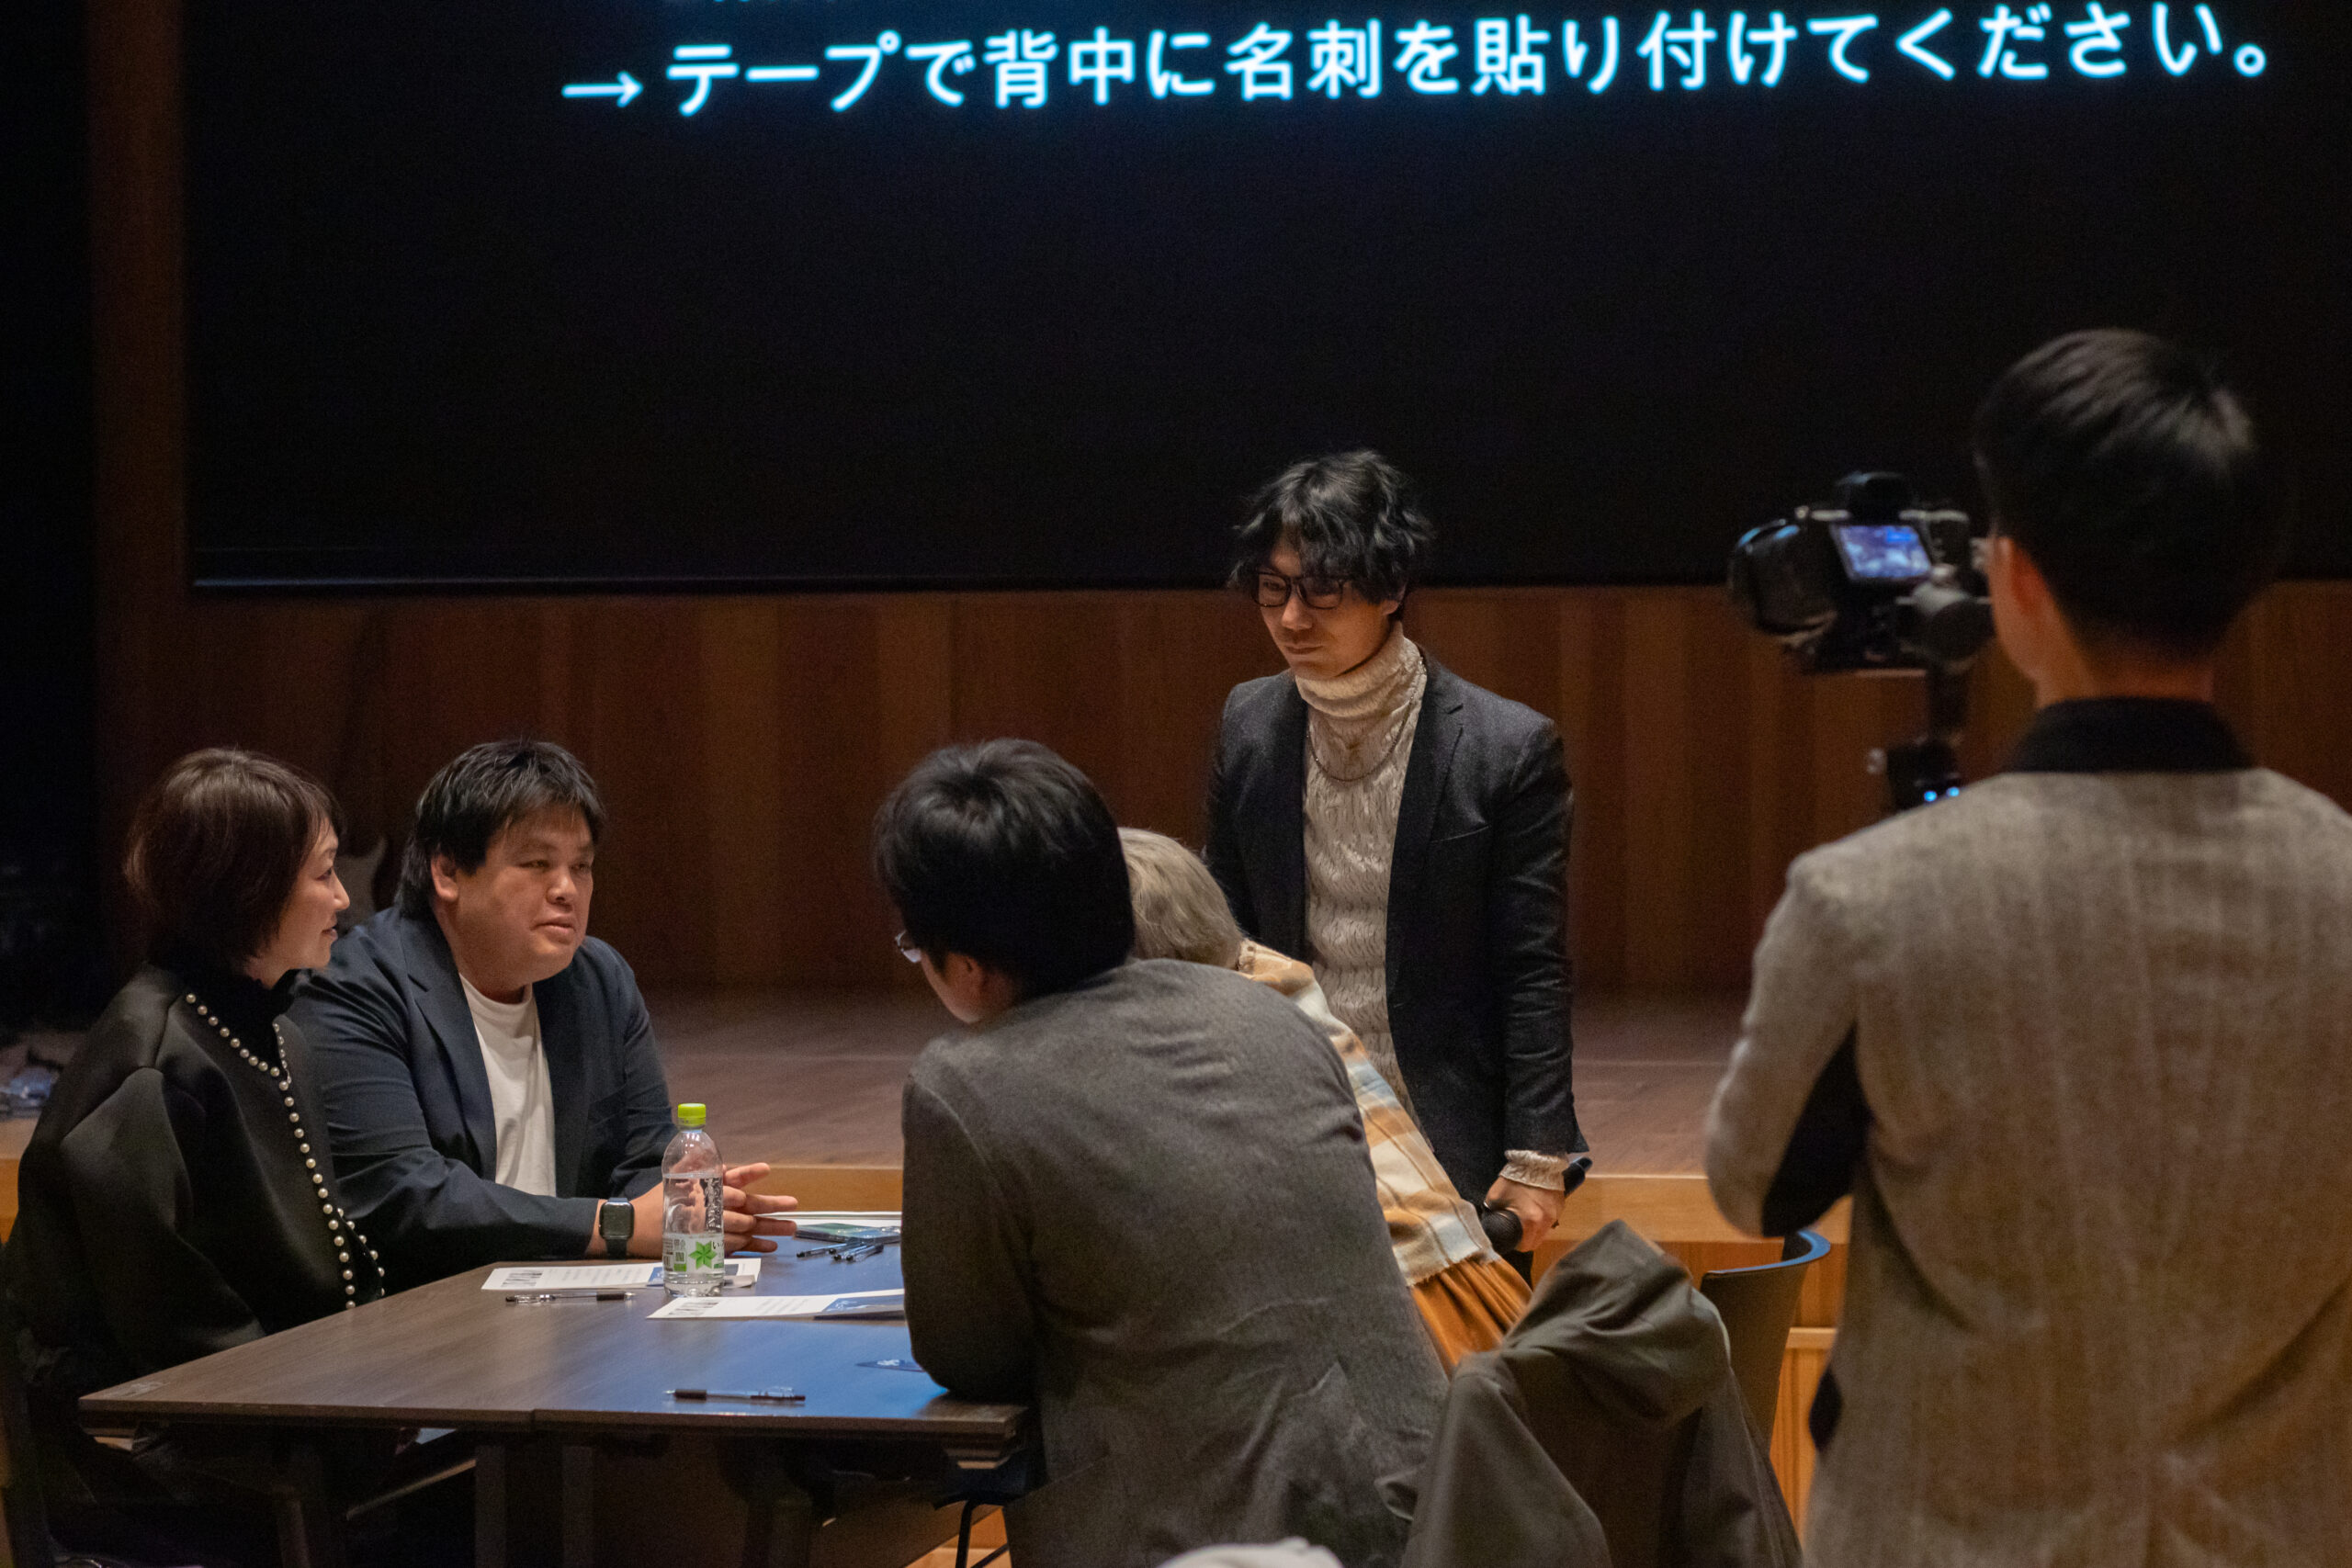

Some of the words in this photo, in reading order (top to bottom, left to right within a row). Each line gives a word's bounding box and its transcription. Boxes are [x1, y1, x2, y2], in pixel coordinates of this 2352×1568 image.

[664, 0, 2267, 118] テープで背中に名刺を貼り付けてください。
